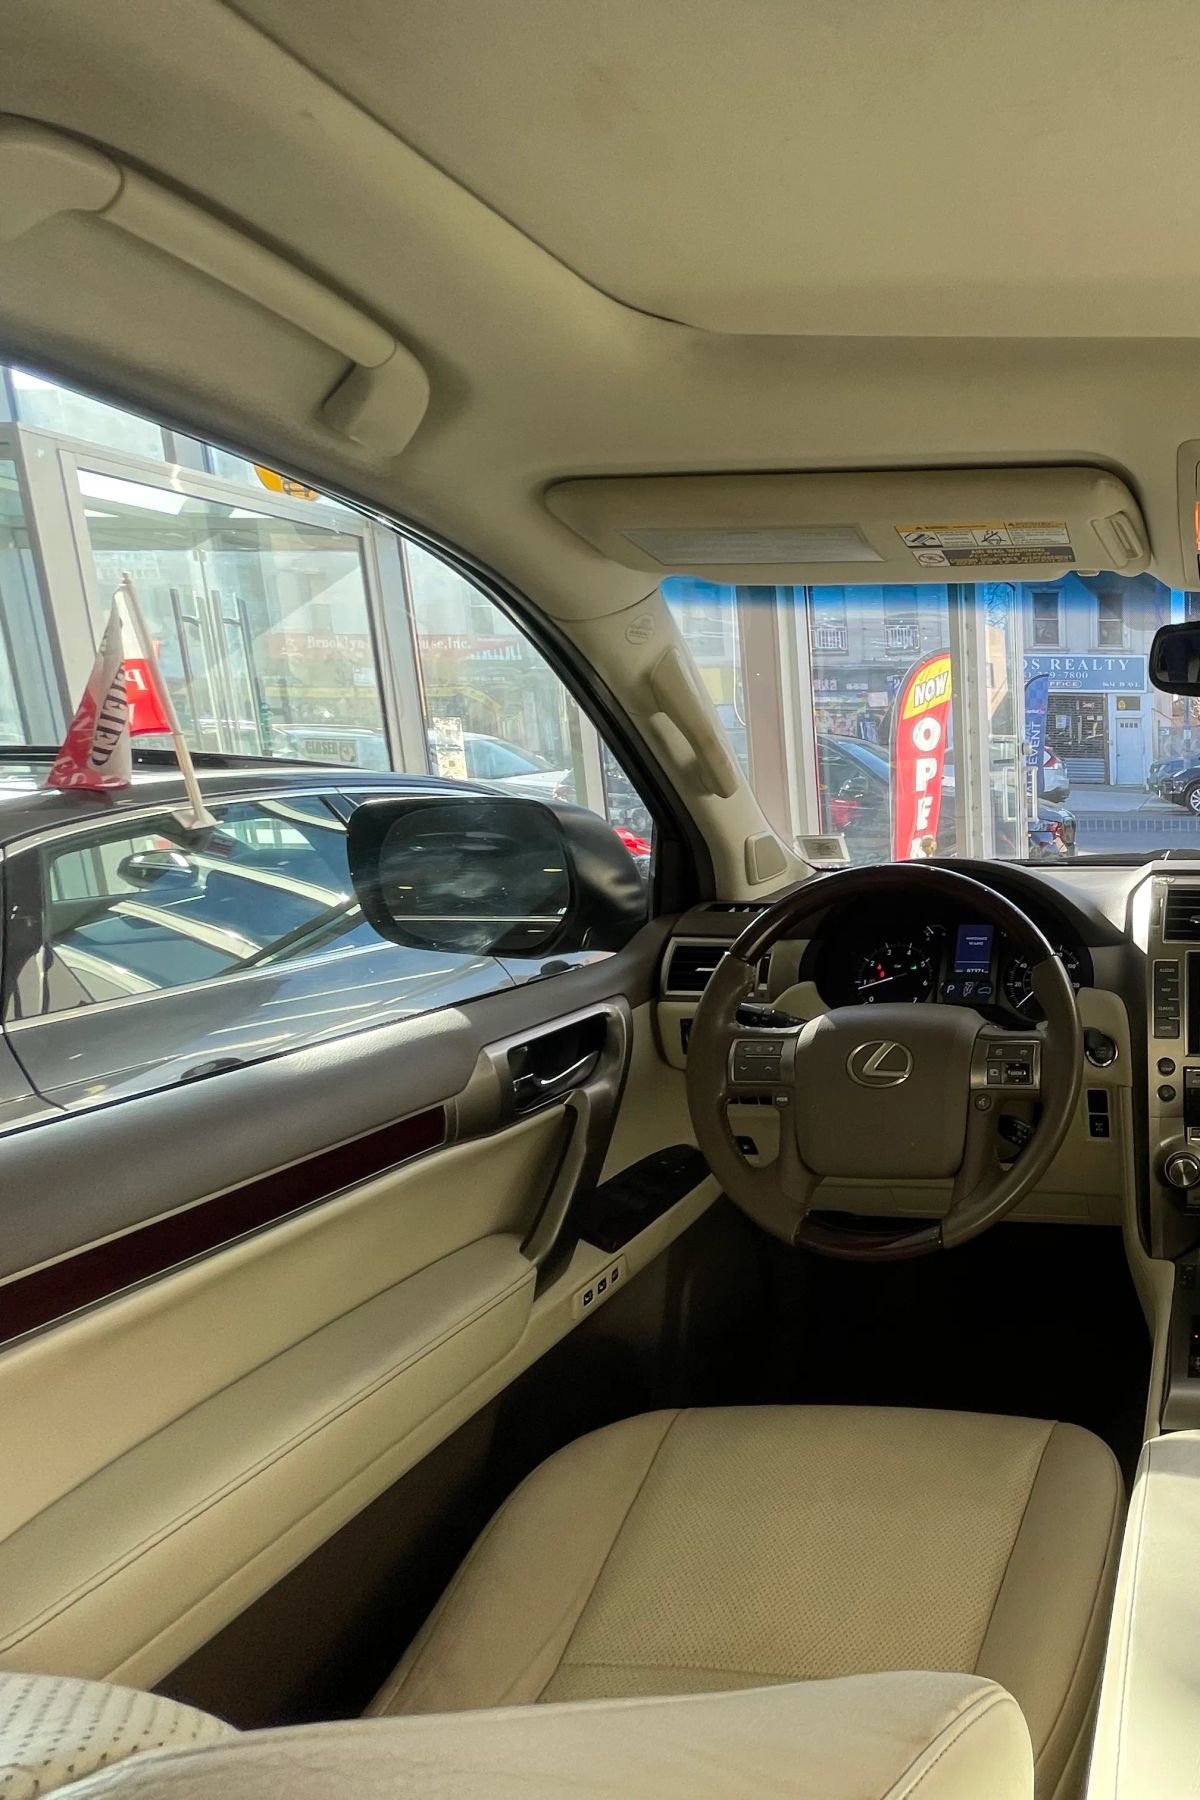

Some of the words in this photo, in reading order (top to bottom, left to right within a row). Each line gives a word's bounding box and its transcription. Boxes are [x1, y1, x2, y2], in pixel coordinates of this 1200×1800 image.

[307, 636, 366, 652] Brooklyn
[1050, 658, 1129, 671] REALTY
[914, 671, 949, 708] NOW
[1028, 721, 1041, 765] EVENT
